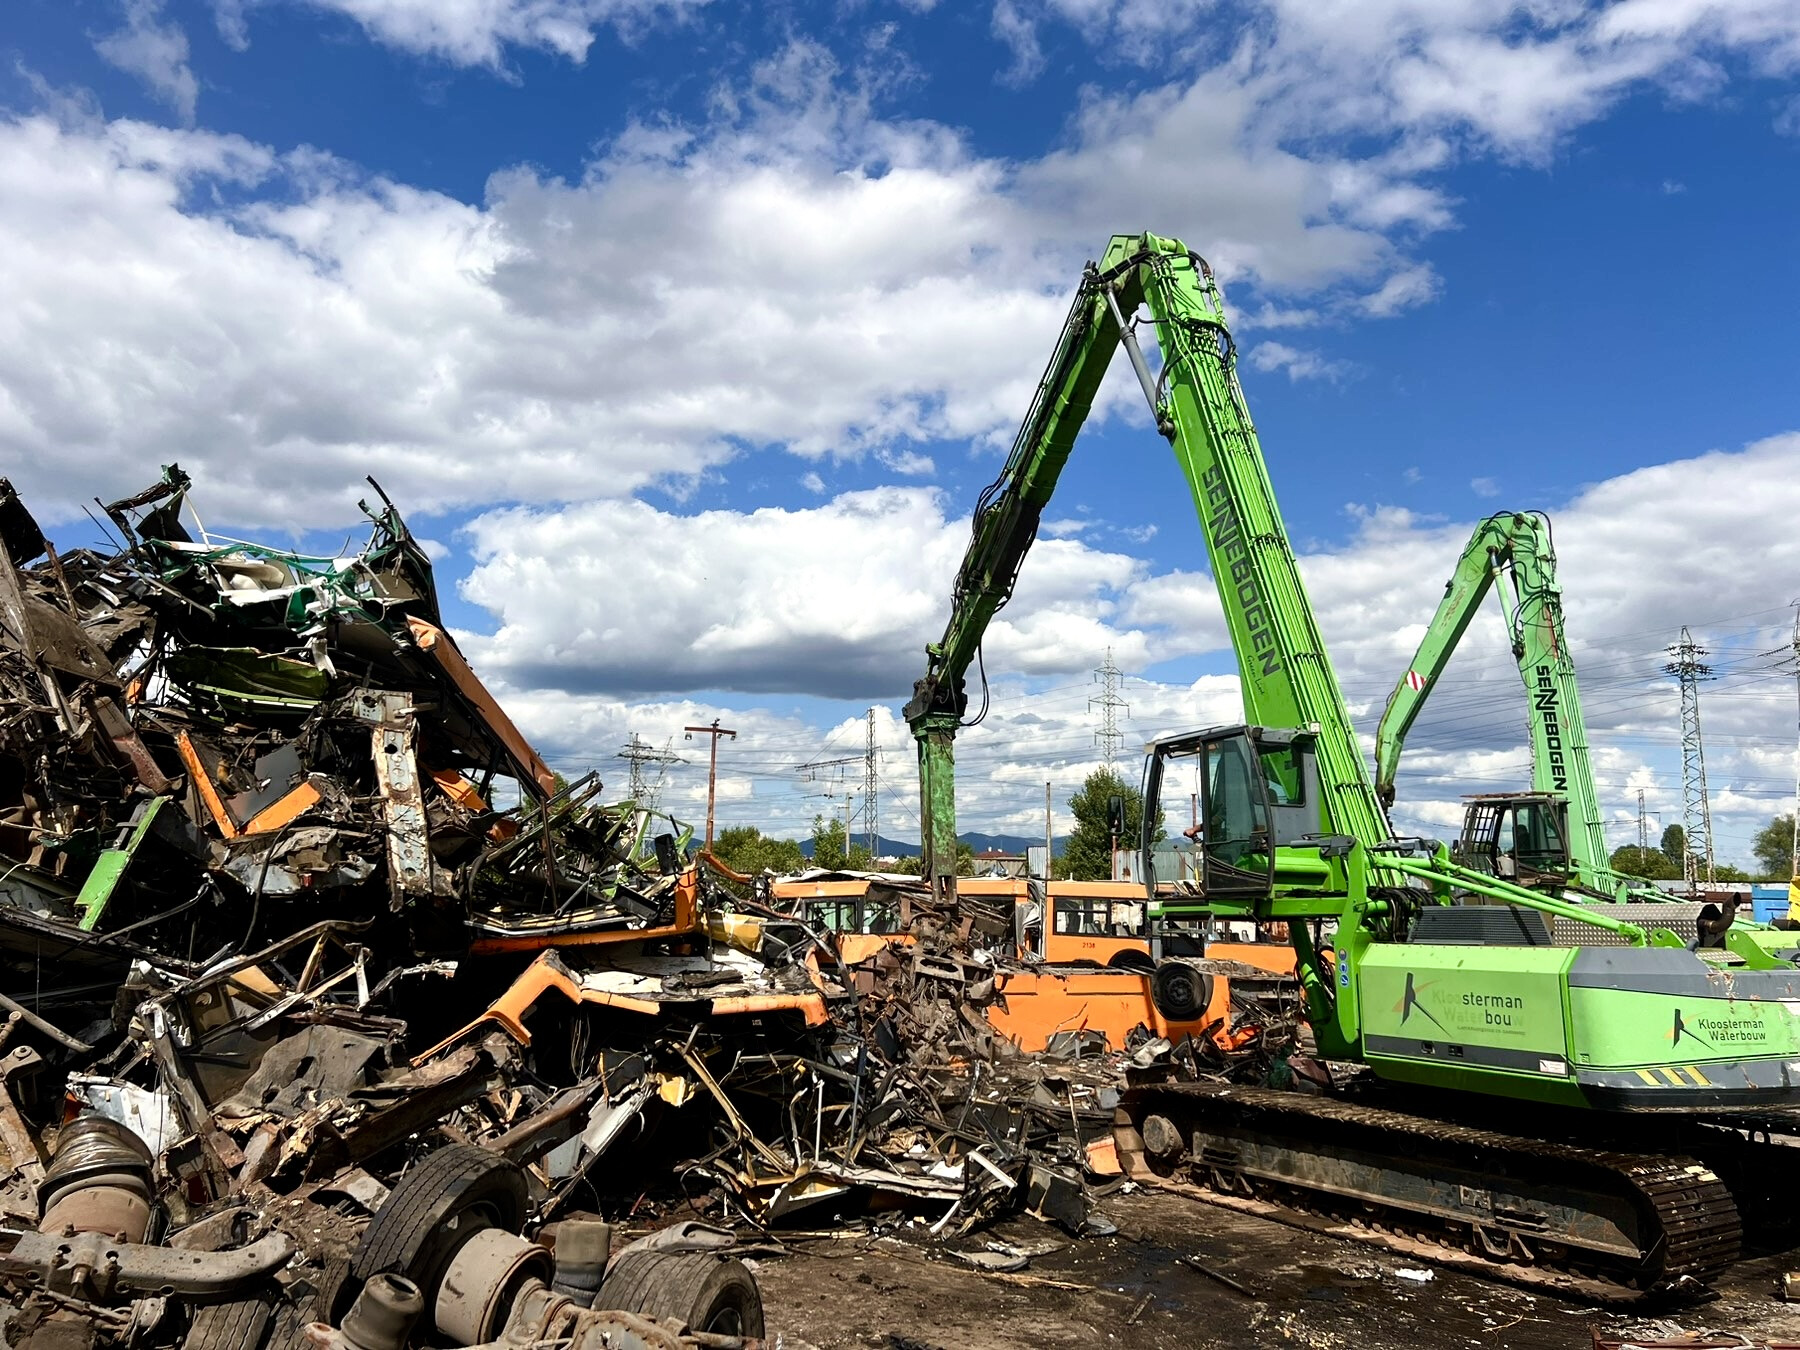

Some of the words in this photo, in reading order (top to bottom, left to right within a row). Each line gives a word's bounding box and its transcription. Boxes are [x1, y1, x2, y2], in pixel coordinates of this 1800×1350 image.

[1202, 463, 1281, 677] SENNEBOGEN
[1534, 665, 1568, 791] SENNEBOGEN
[1698, 1018, 1764, 1029] Kloosterman
[1708, 1030, 1766, 1041] Waterbouw
